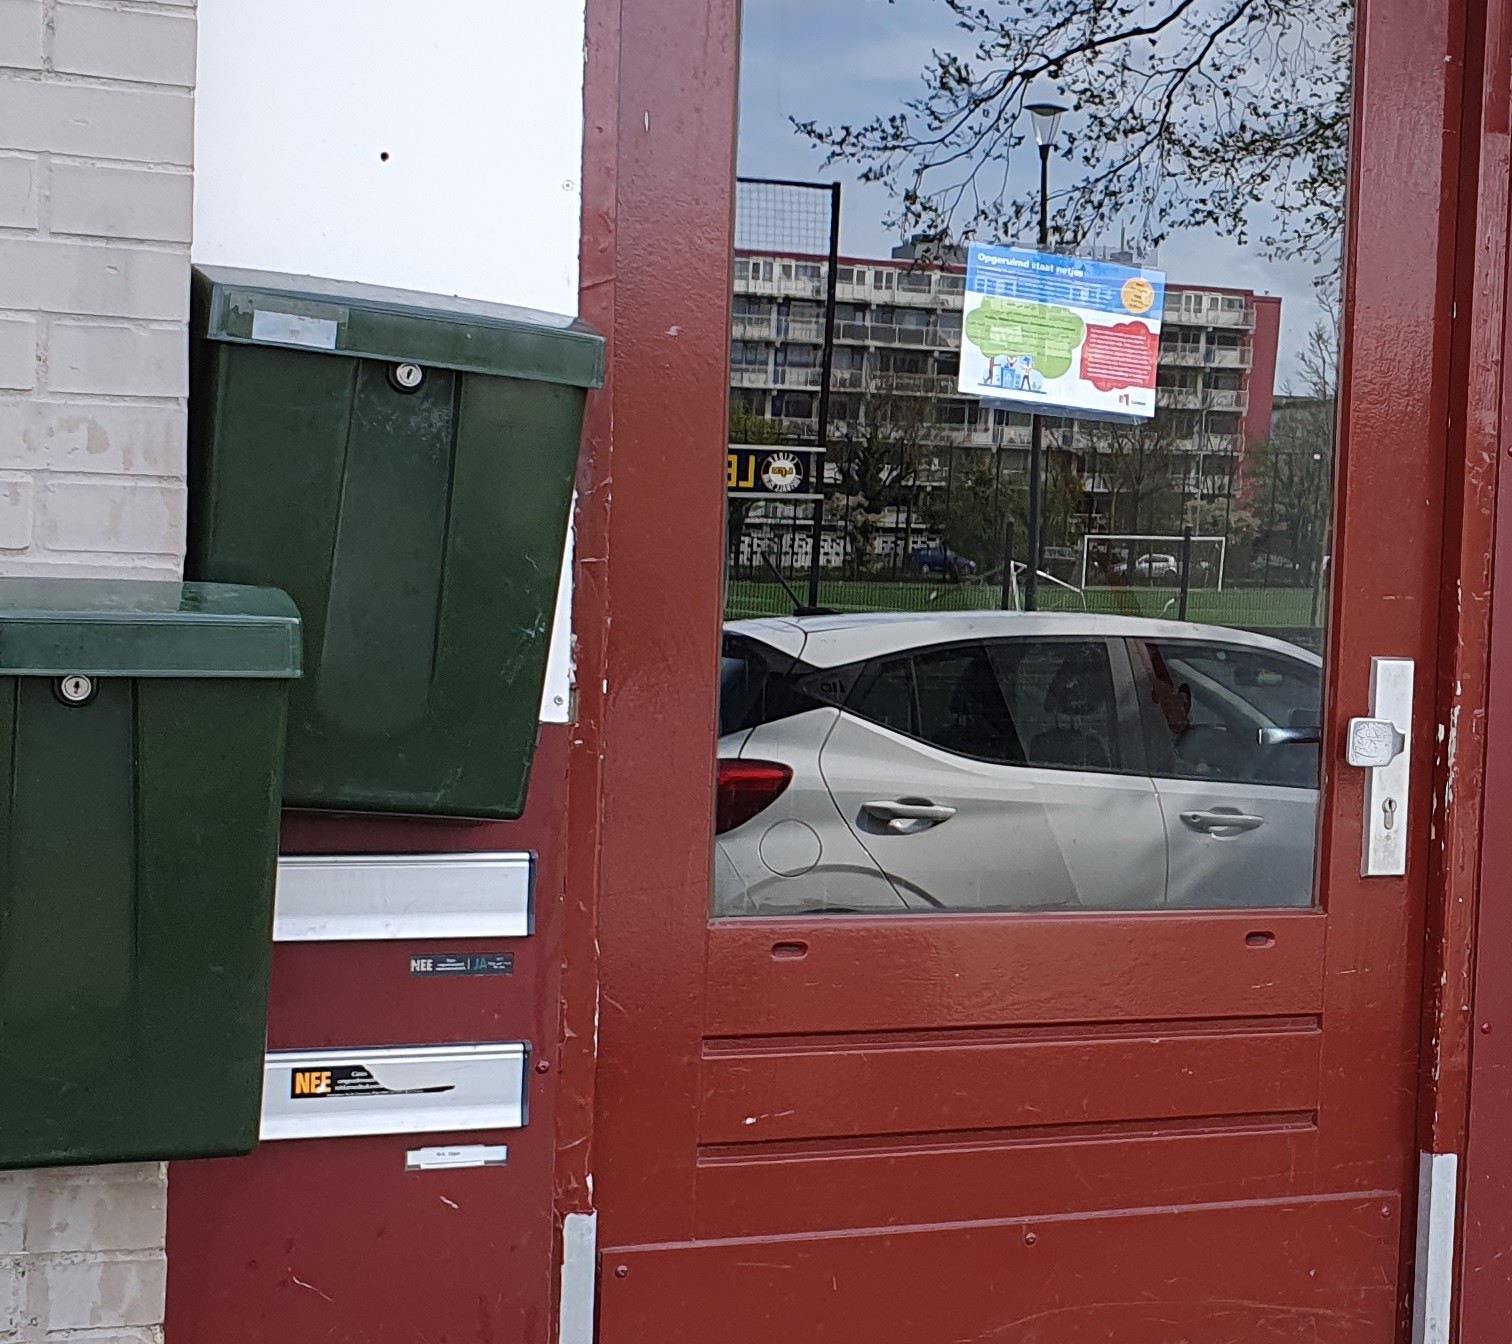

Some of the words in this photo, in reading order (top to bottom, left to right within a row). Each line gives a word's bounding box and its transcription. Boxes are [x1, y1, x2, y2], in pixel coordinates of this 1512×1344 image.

[977, 252, 1030, 269] Opgeruimd
[1031, 261, 1054, 273] staat
[410, 959, 433, 972] NEE
[473, 957, 487, 970] JA
[295, 1071, 331, 1094] NEE
